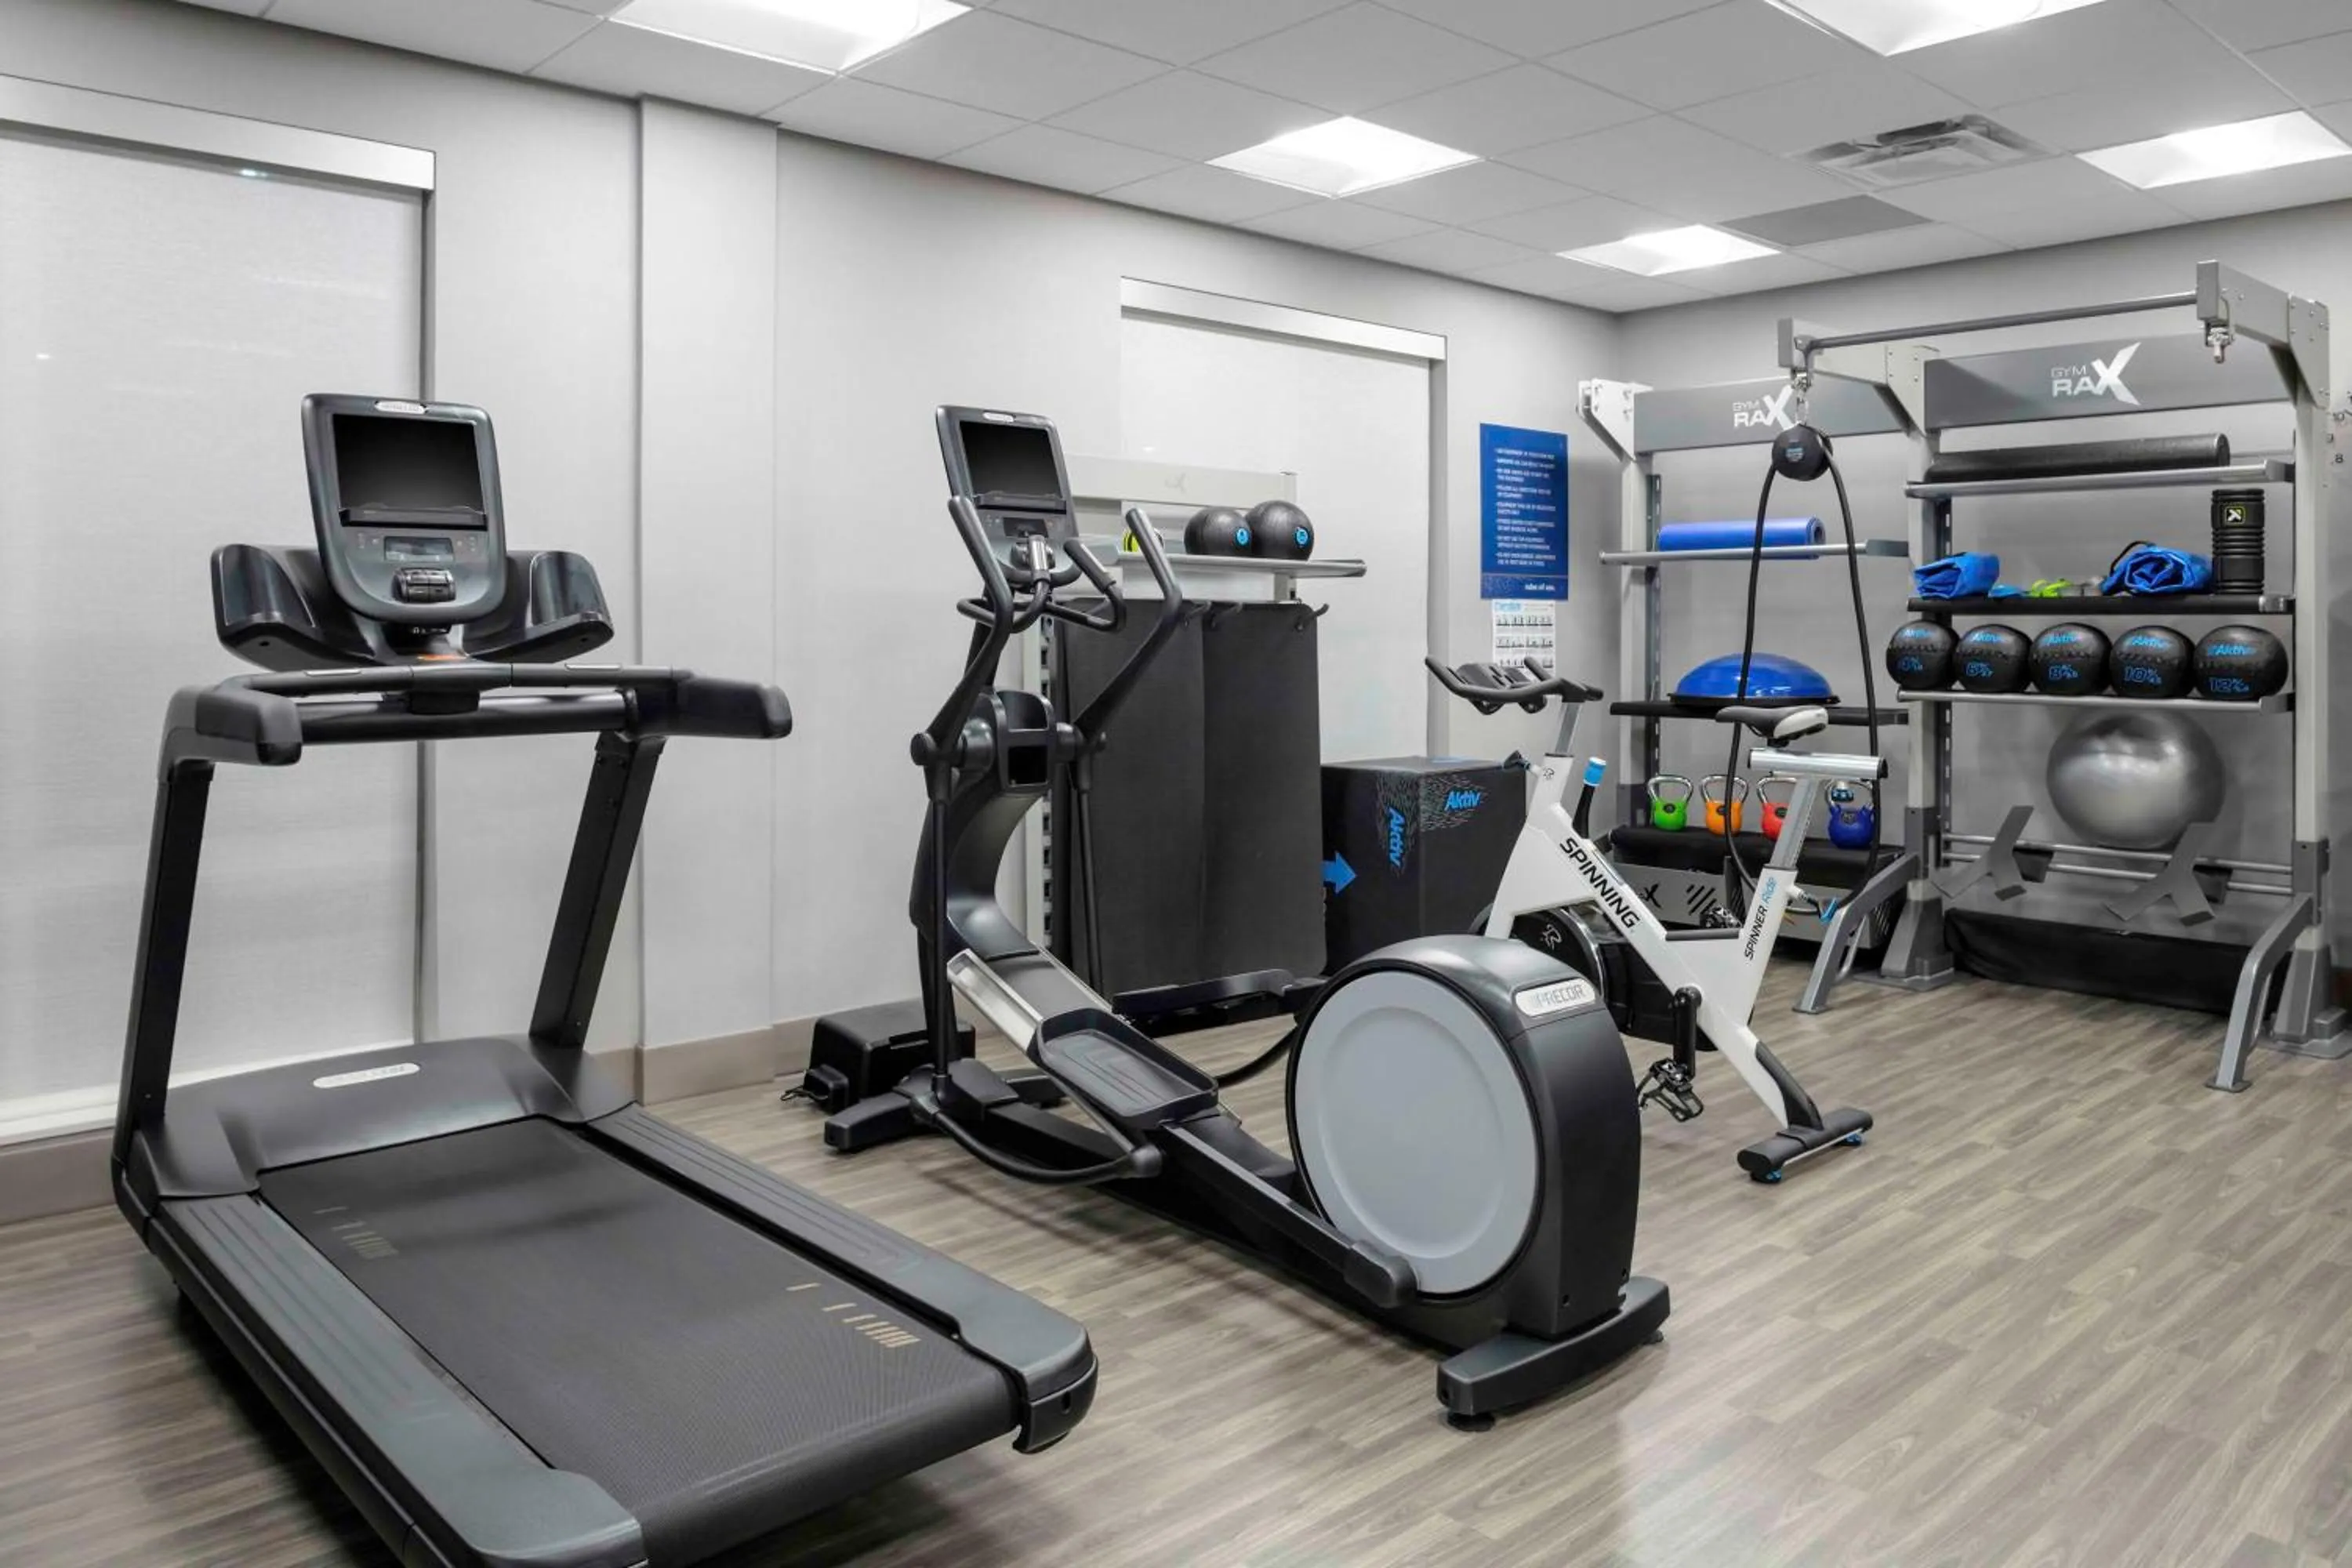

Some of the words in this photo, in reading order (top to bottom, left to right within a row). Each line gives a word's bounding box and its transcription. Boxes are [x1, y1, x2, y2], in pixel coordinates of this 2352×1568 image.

[2051, 365, 2086, 377] GYM
[2053, 342, 2141, 405] RAX
[1733, 384, 1794, 430] RAX
[1444, 790, 1480, 811] Aktiv
[1388, 807, 1405, 867] Aktiv
[1559, 837, 1641, 928] SPINNING
[1744, 905, 1767, 960] SPINNER
